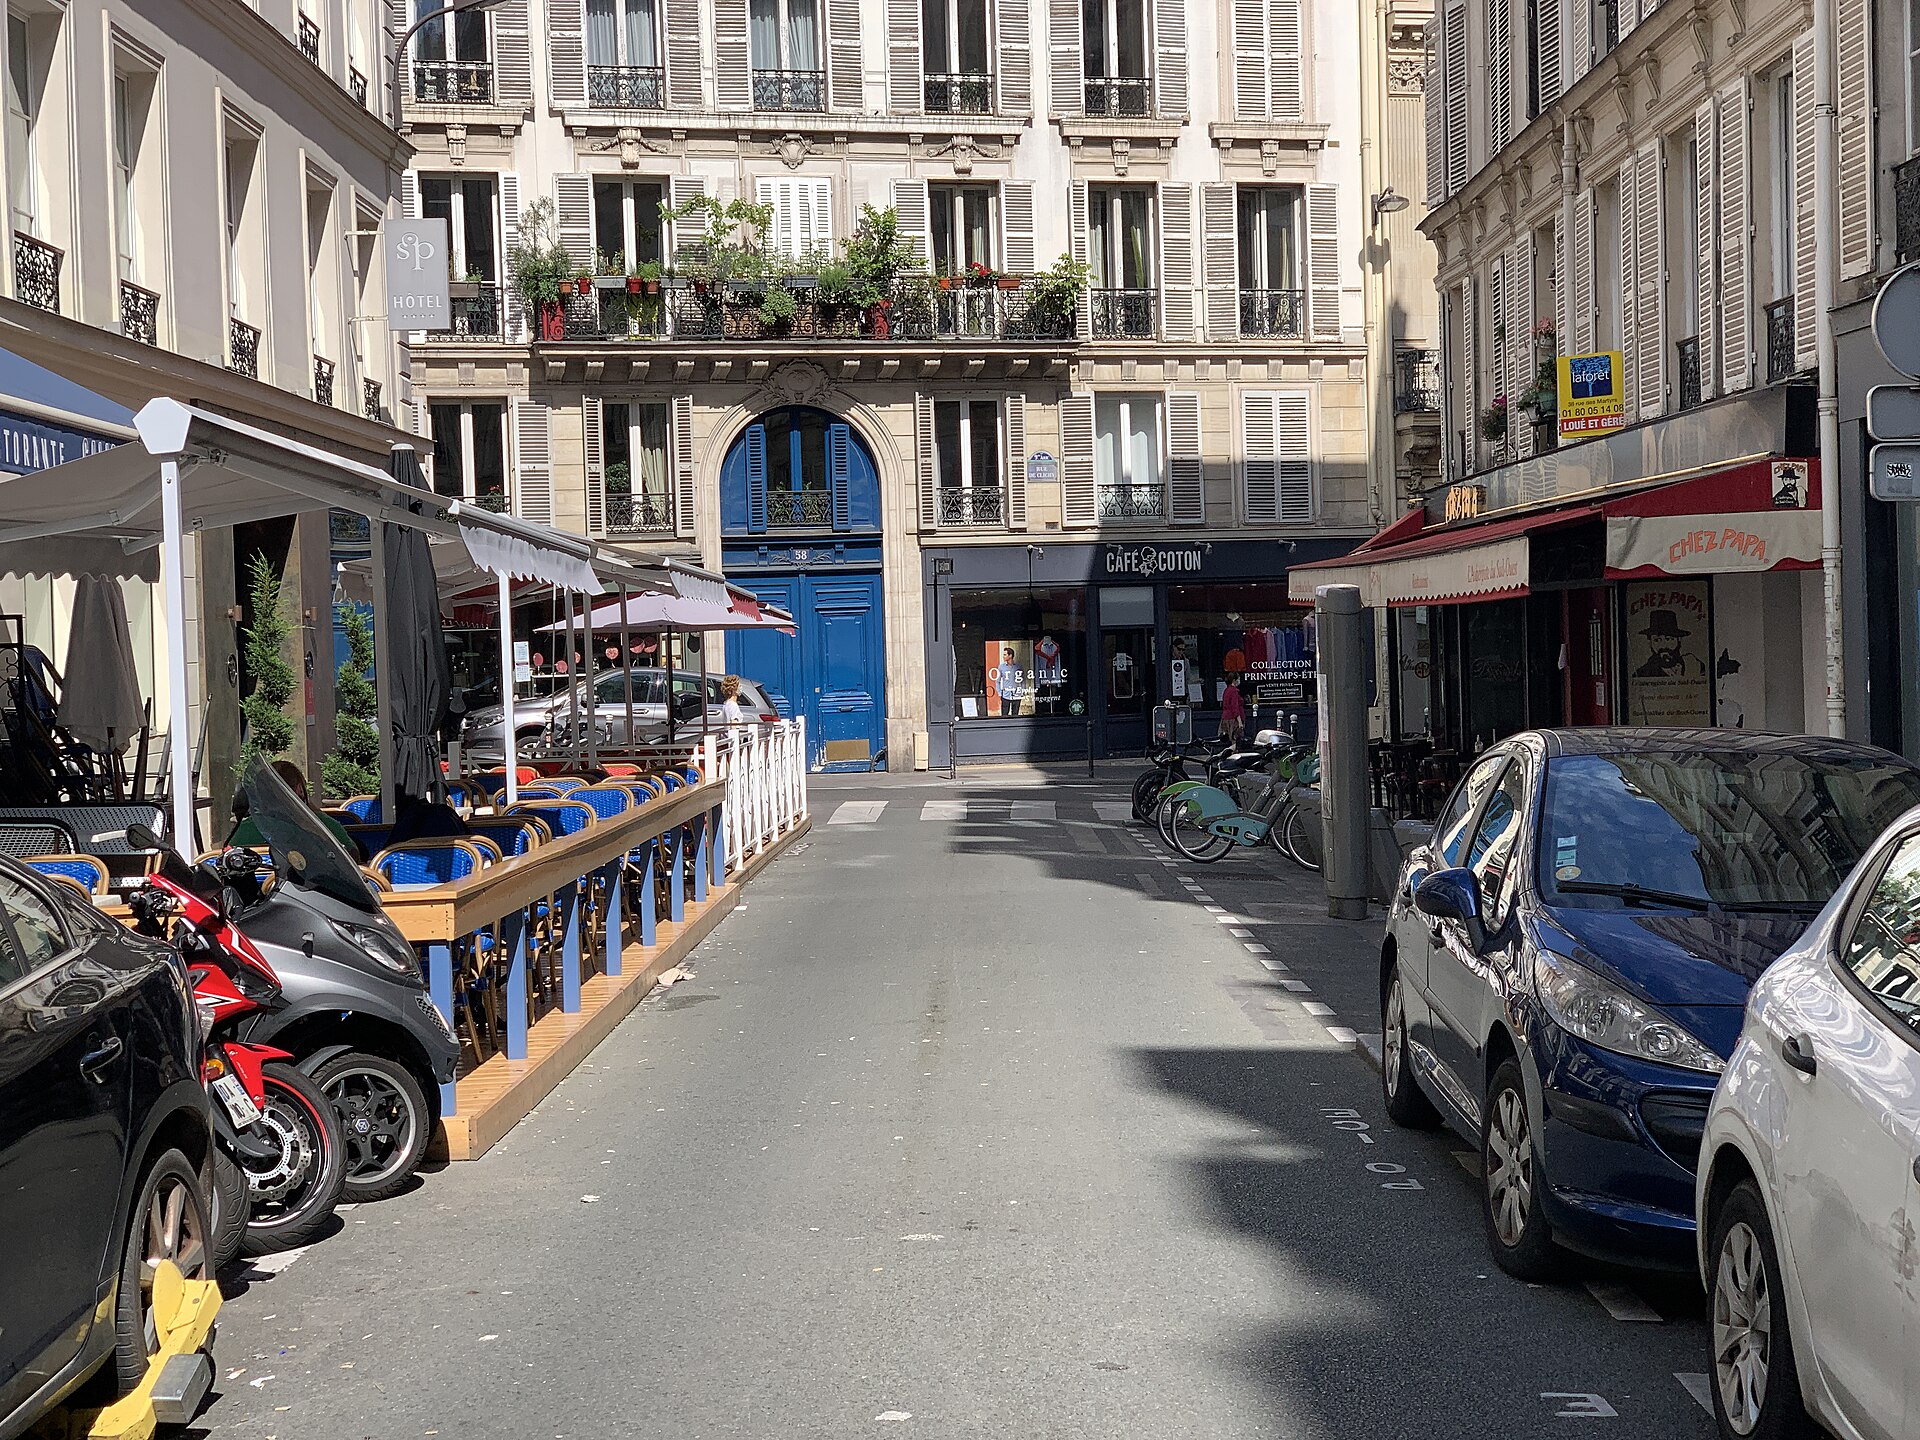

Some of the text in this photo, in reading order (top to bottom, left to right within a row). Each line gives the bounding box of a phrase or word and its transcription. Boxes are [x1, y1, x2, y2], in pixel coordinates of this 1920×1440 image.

[393, 292, 442, 309] HÔTEL
[1572, 369, 1610, 383] laforêt
[1562, 404, 1624, 418] 01 80 05 14 08
[1564, 414, 1624, 431] LOUÉ ET GÉRÉ
[1669, 528, 1767, 564] CHEZ PAPA
[795, 550, 807, 560] 58
[1106, 548, 1201, 573] CAFÉ COTON
[1630, 592, 1703, 616] CHEZ PAPA
[1251, 660, 1312, 670] COLLECTION
[988, 665, 1068, 683] Organic
